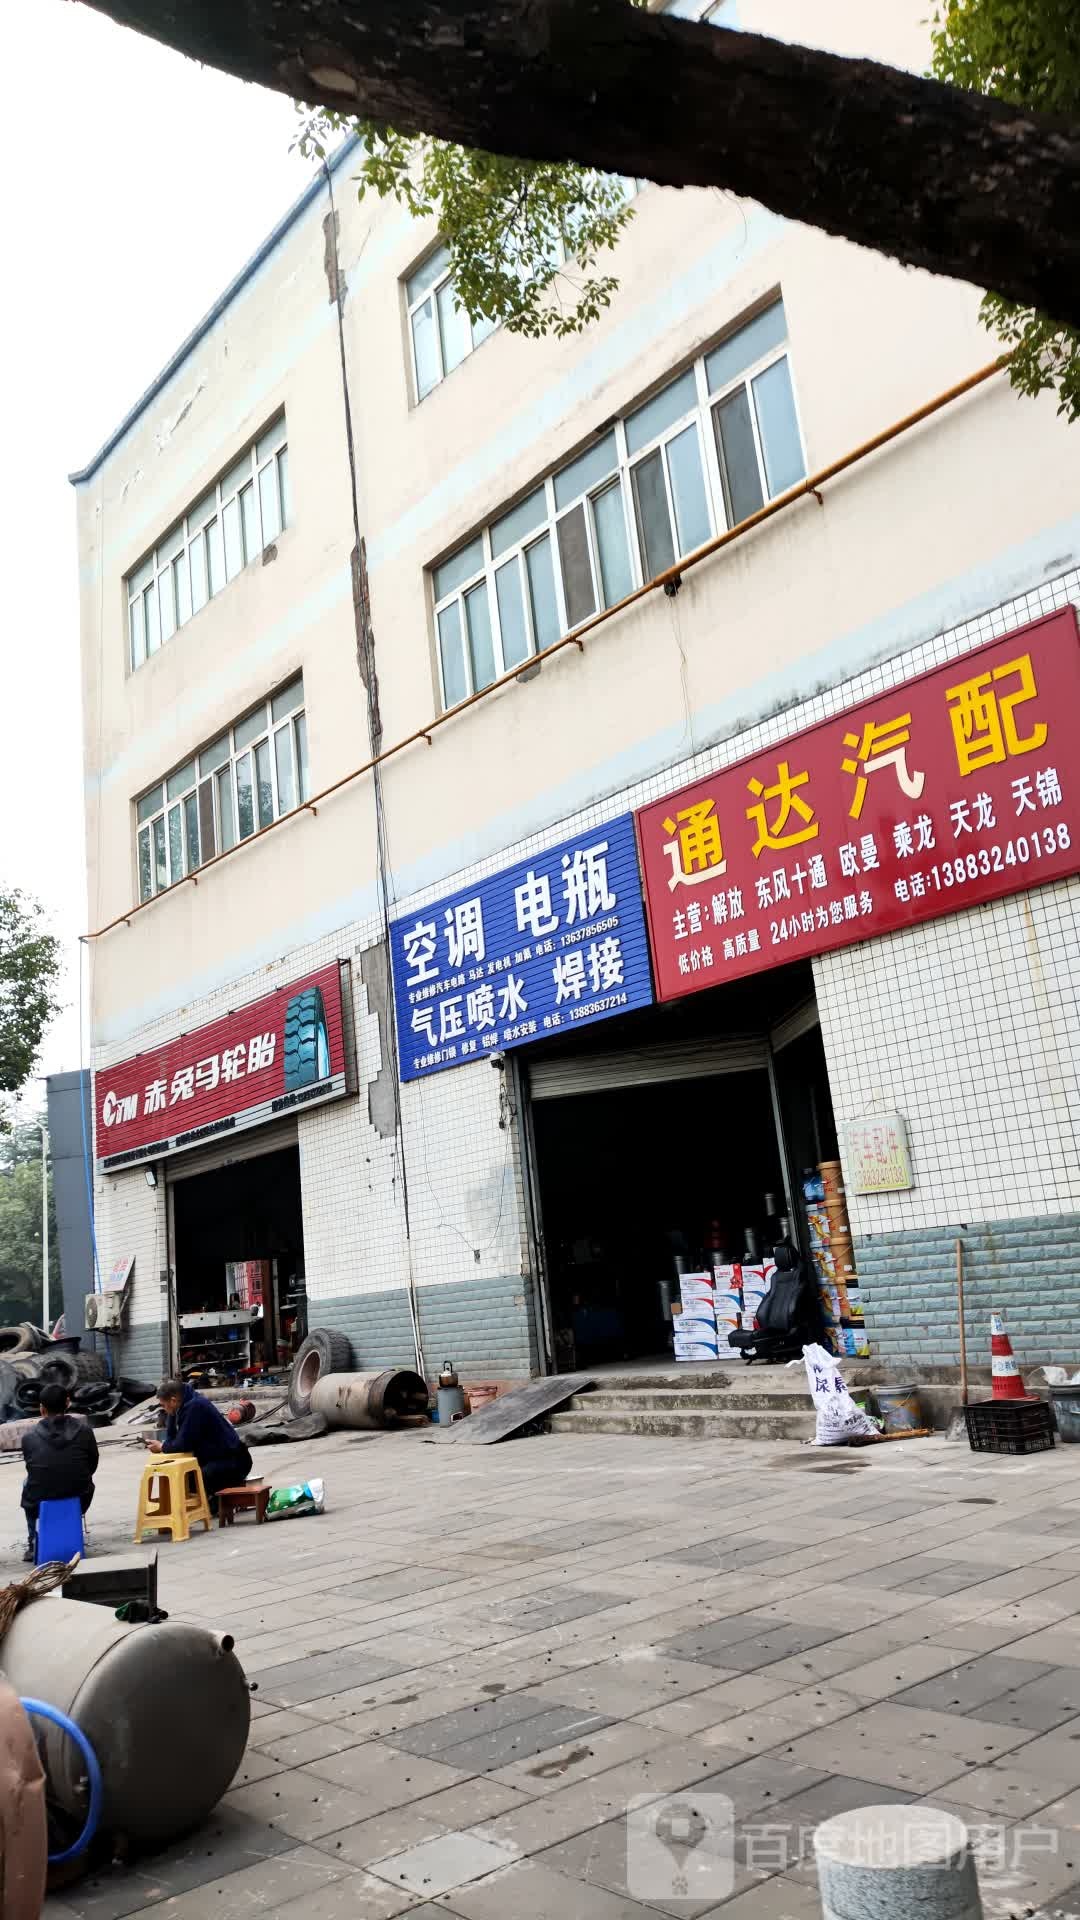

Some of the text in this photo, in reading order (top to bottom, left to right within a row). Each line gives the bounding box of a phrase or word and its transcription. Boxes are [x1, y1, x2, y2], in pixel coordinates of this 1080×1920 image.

[662, 653, 1049, 893] 通达汽配
[756, 856, 829, 910] 东风十通
[839, 834, 880, 876] 欧曼
[893, 815, 935, 860] 乘龙
[950, 793, 996, 839] 天龙
[1012, 767, 1062, 818] 天锦
[403, 841, 616, 987] 空调 电瓶
[468, 968, 484, 982] 马达
[487, 955, 512, 975] 发电机
[678, 943, 714, 976] 低价格
[723, 929, 761, 962] 高质量
[771, 893, 874, 944] 24小时为您服务
[411, 936, 624, 1047] 气压喷水 焊接
[143, 1032, 276, 1115] 赤兔马轮胎
